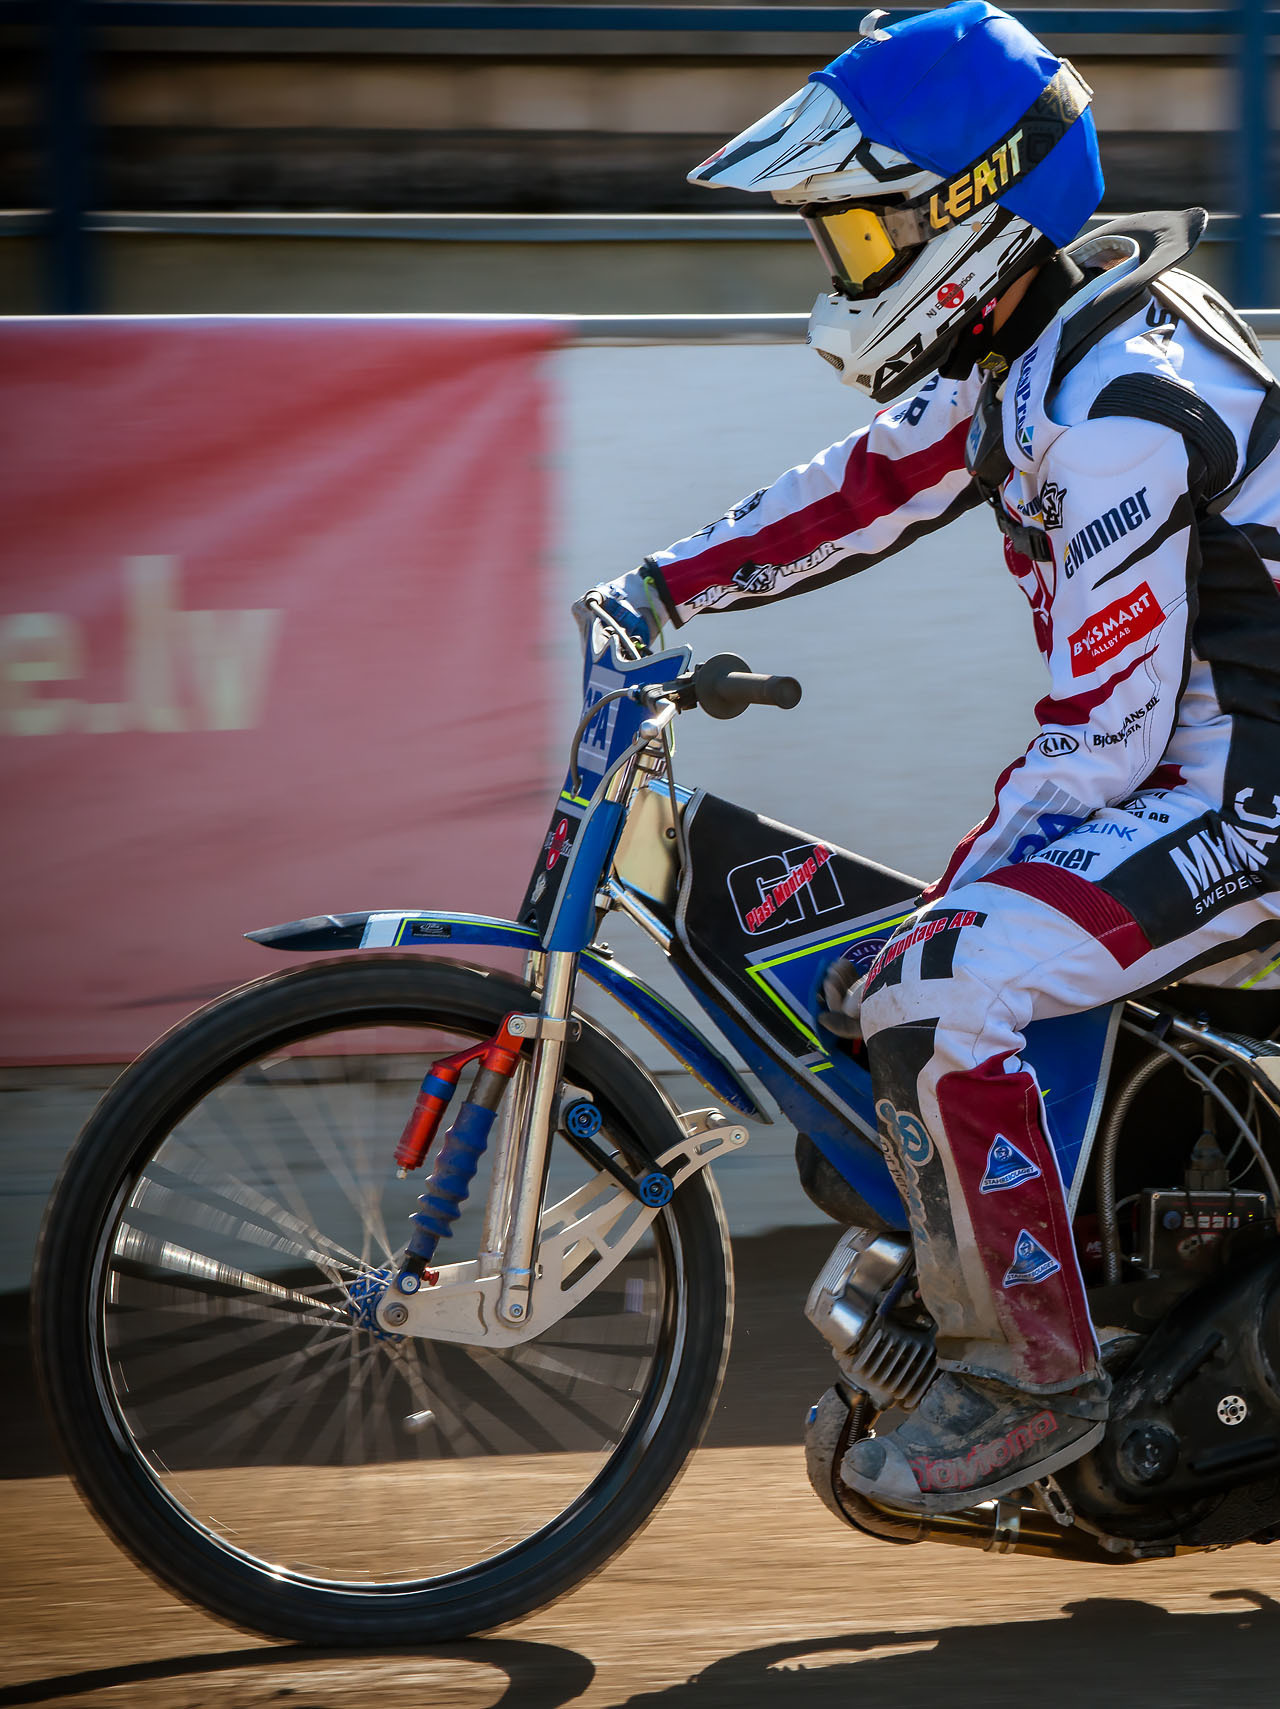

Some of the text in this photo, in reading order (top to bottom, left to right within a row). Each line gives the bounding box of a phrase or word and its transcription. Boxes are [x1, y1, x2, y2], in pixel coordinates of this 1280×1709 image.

[929, 129, 1024, 230] LEATT
[1063, 486, 1152, 580] ewinner
[1043, 737, 1073, 754] KIA
[771, 856, 818, 908] Montage
[883, 916, 949, 968] Montage
[947, 910, 978, 930] AB
